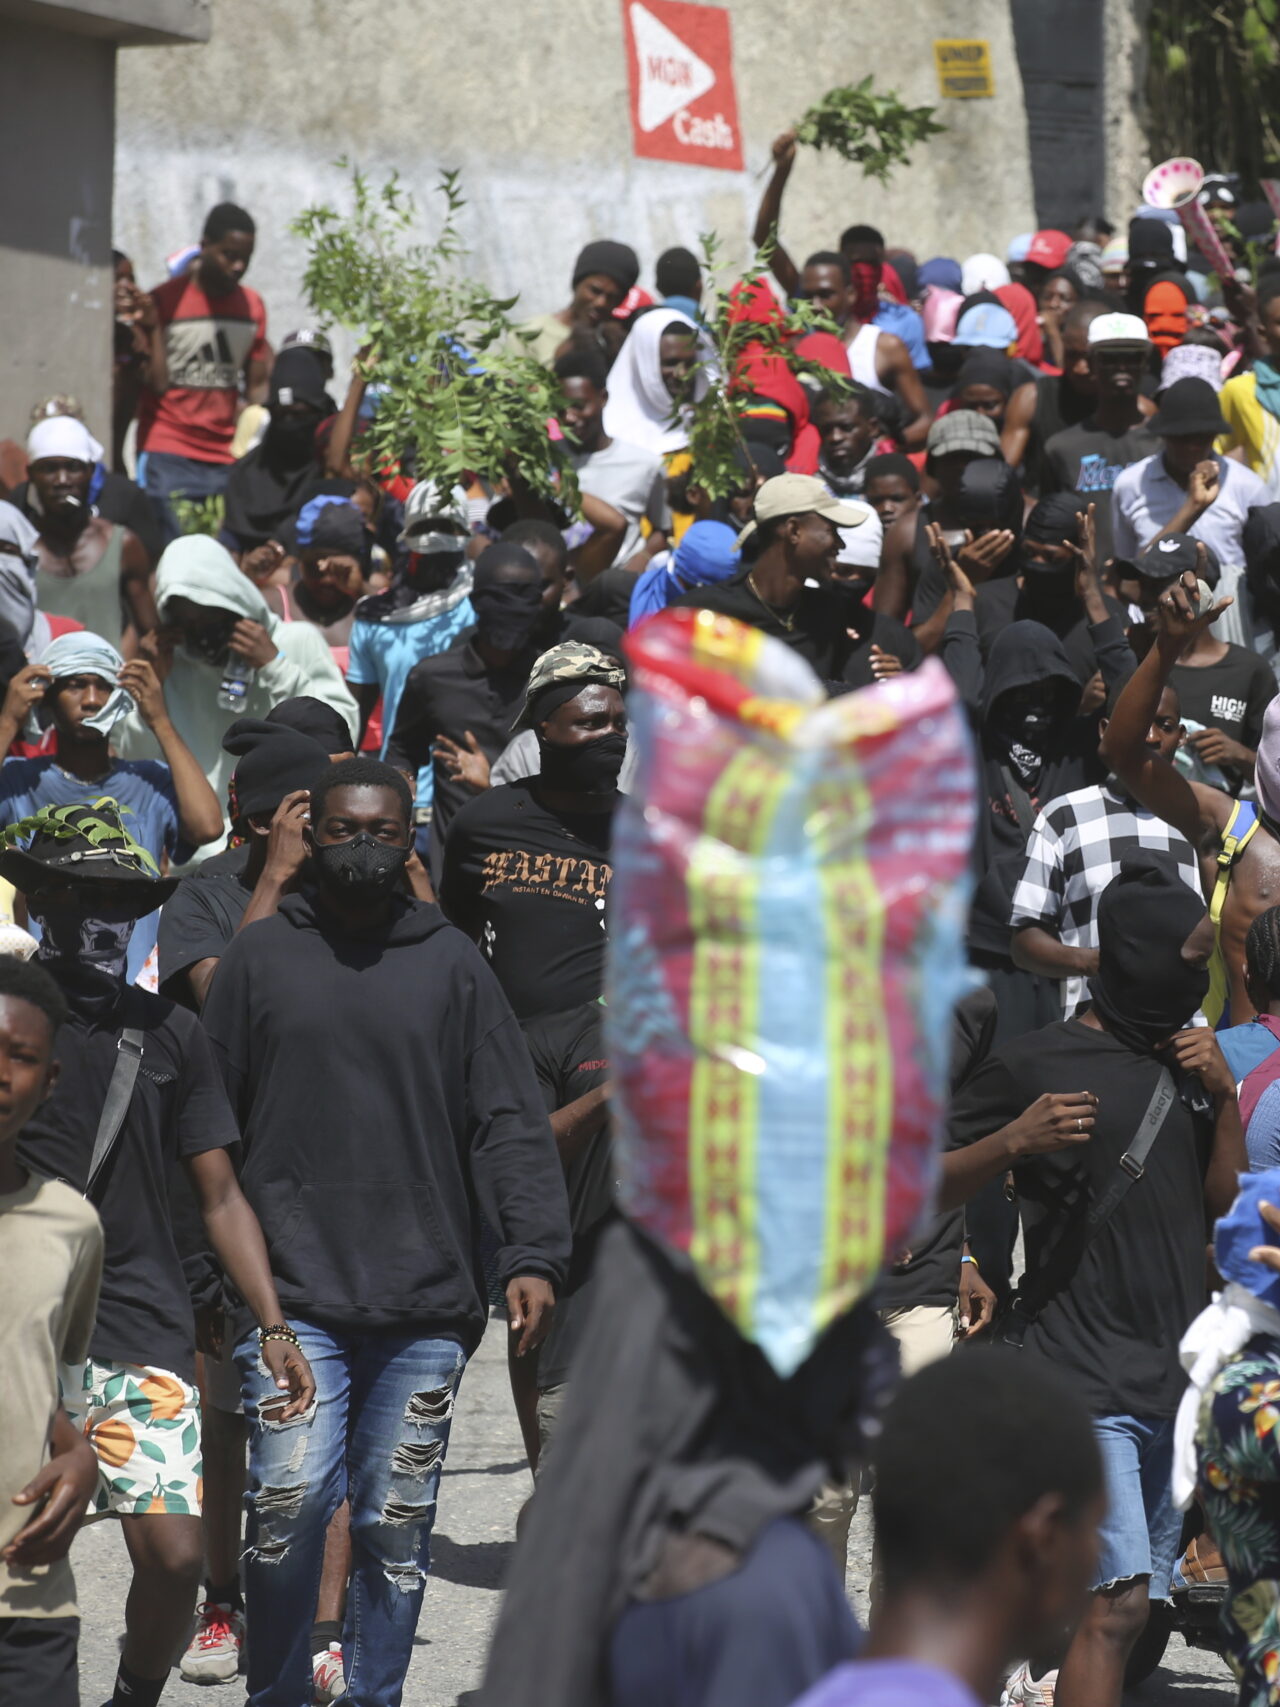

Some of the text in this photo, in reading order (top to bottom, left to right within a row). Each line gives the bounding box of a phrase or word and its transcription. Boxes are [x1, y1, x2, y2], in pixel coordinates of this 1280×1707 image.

[672, 109, 734, 149] Cash
[1210, 695, 1247, 716] HIGH
[1149, 1086, 1173, 1126] Jeep
